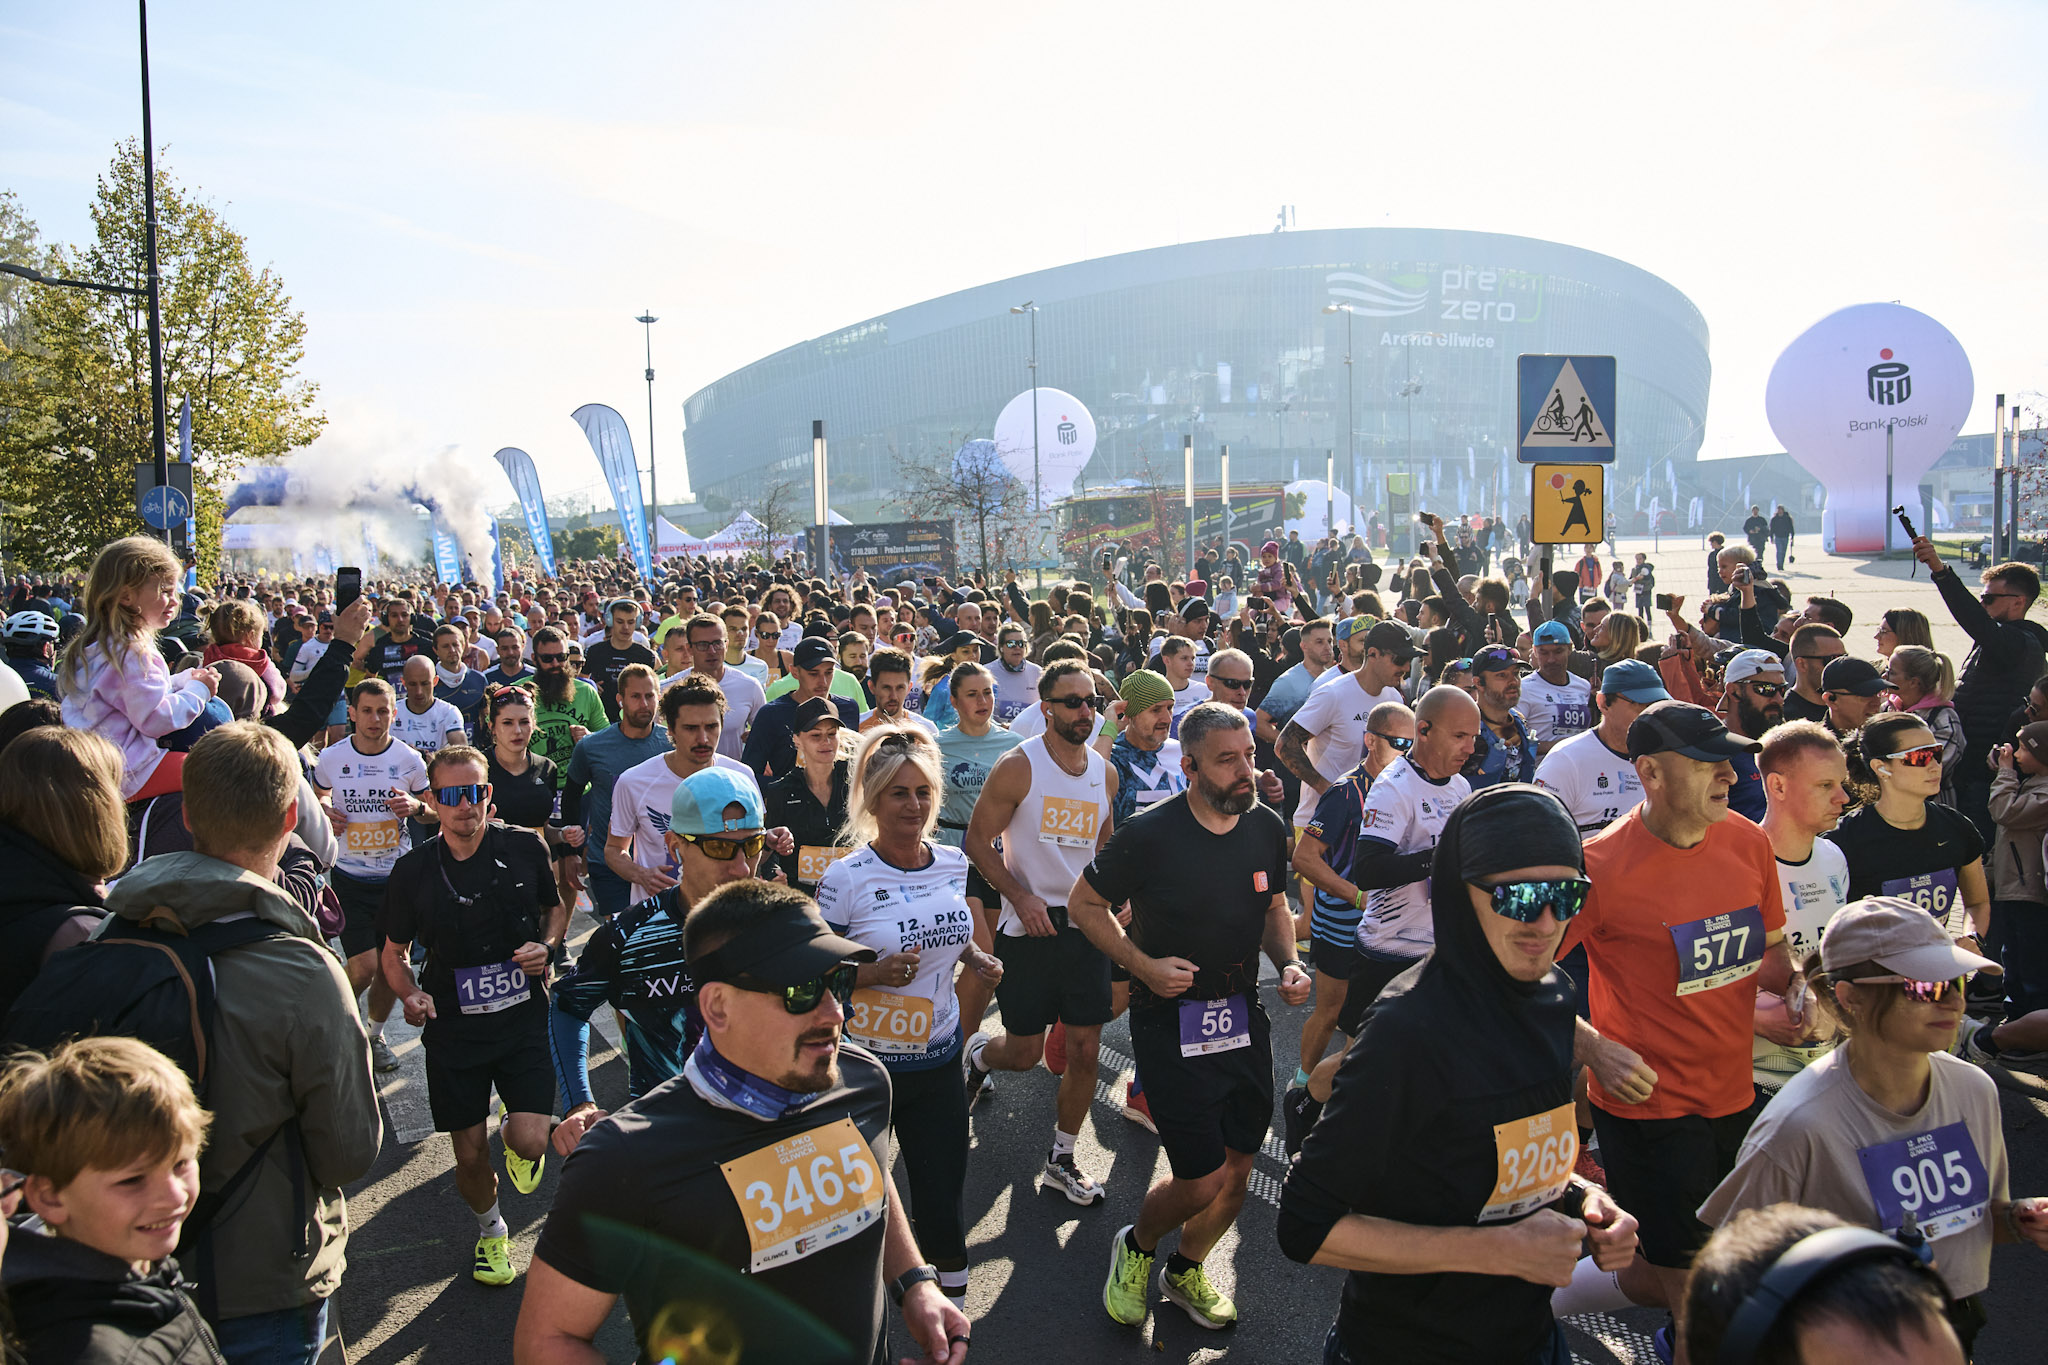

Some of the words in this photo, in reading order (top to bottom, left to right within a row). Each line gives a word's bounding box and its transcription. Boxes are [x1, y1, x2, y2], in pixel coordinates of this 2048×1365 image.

[1440, 299, 1516, 323] zero
[1380, 331, 1432, 347] Arena
[1436, 332, 1496, 349] Gliwice
[1849, 418, 1886, 432] Bank
[1889, 414, 1929, 428] Polski
[1564, 710, 1585, 726] 991
[342, 789, 361, 798] 12.
[369, 789, 396, 798] PKO
[1045, 807, 1094, 834] 3241
[350, 828, 397, 847] 3292
[897, 918, 925, 933] 12.
[934, 910, 968, 925] PKO
[1705, 922, 1732, 932] GLIWICKI
[1715, 914, 1730, 922] PKO
[900, 924, 970, 944] PÓŁMARATON
[1693, 925, 1750, 971] 577
[462, 968, 526, 1001] 1550
[645, 975, 680, 998] XV
[851, 1002, 927, 1037] 3760
[1201, 1008, 1232, 1036] 56
[900, 1054, 912, 1062] PO
[914, 1048, 940, 1061] SWOJE
[774, 1144, 788, 1154] 12.
[792, 1135, 812, 1147] PKO
[1917, 1134, 1933, 1144] PKO
[780, 1146, 817, 1165] GLIWICKI
[1500, 1130, 1575, 1195] 3269
[745, 1143, 874, 1233] 3465
[1892, 1150, 1972, 1211] 905
[763, 1250, 789, 1262] GLIWICE
